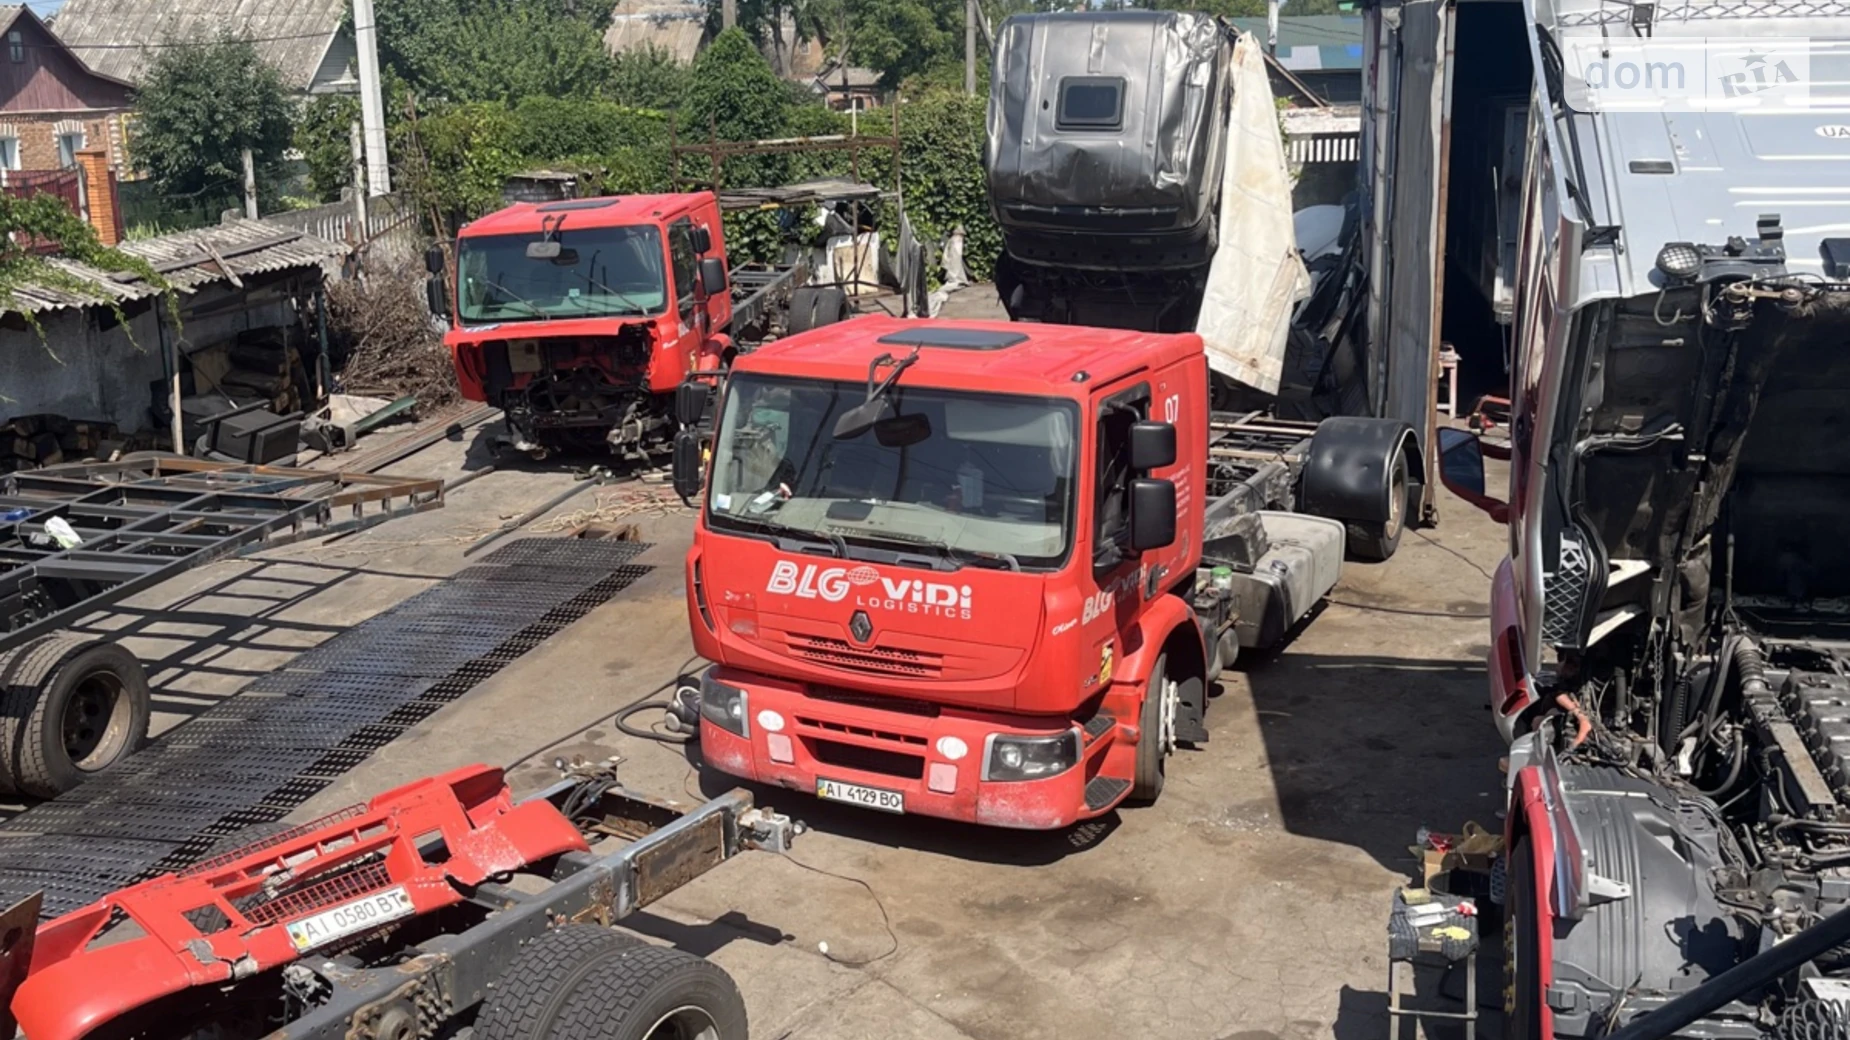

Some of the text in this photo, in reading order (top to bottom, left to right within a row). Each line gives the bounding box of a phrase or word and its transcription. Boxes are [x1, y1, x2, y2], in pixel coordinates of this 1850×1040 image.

[1165, 394, 1179, 424] 07
[766, 560, 850, 602] BLG
[856, 595, 972, 620] LOGISTICS
[826, 783, 842, 798] AI
[847, 787, 877, 804] 4129
[304, 891, 403, 940] AI 0580 BT
